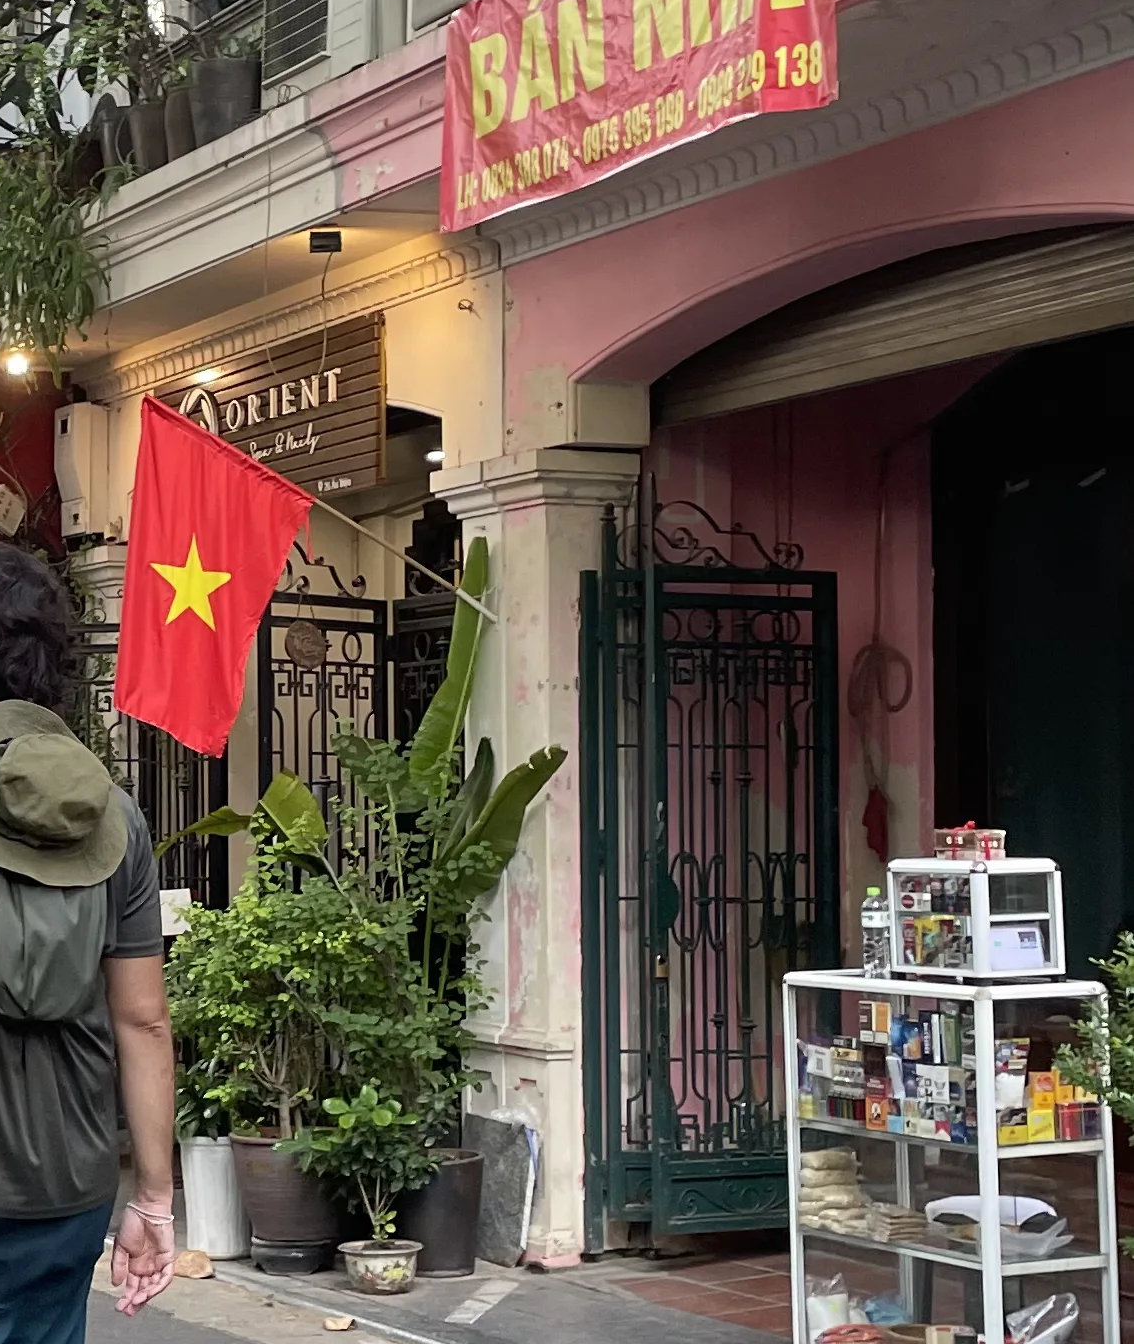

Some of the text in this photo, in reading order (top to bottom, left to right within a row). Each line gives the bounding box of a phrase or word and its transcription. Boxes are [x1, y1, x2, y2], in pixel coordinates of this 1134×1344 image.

[457, 174, 478, 211] LH:
[543, 136, 569, 179] 074
[622, 102, 652, 150] 395
[655, 89, 685, 138] 098
[774, 40, 823, 88] 138
[225, 367, 342, 432] ORIENT
